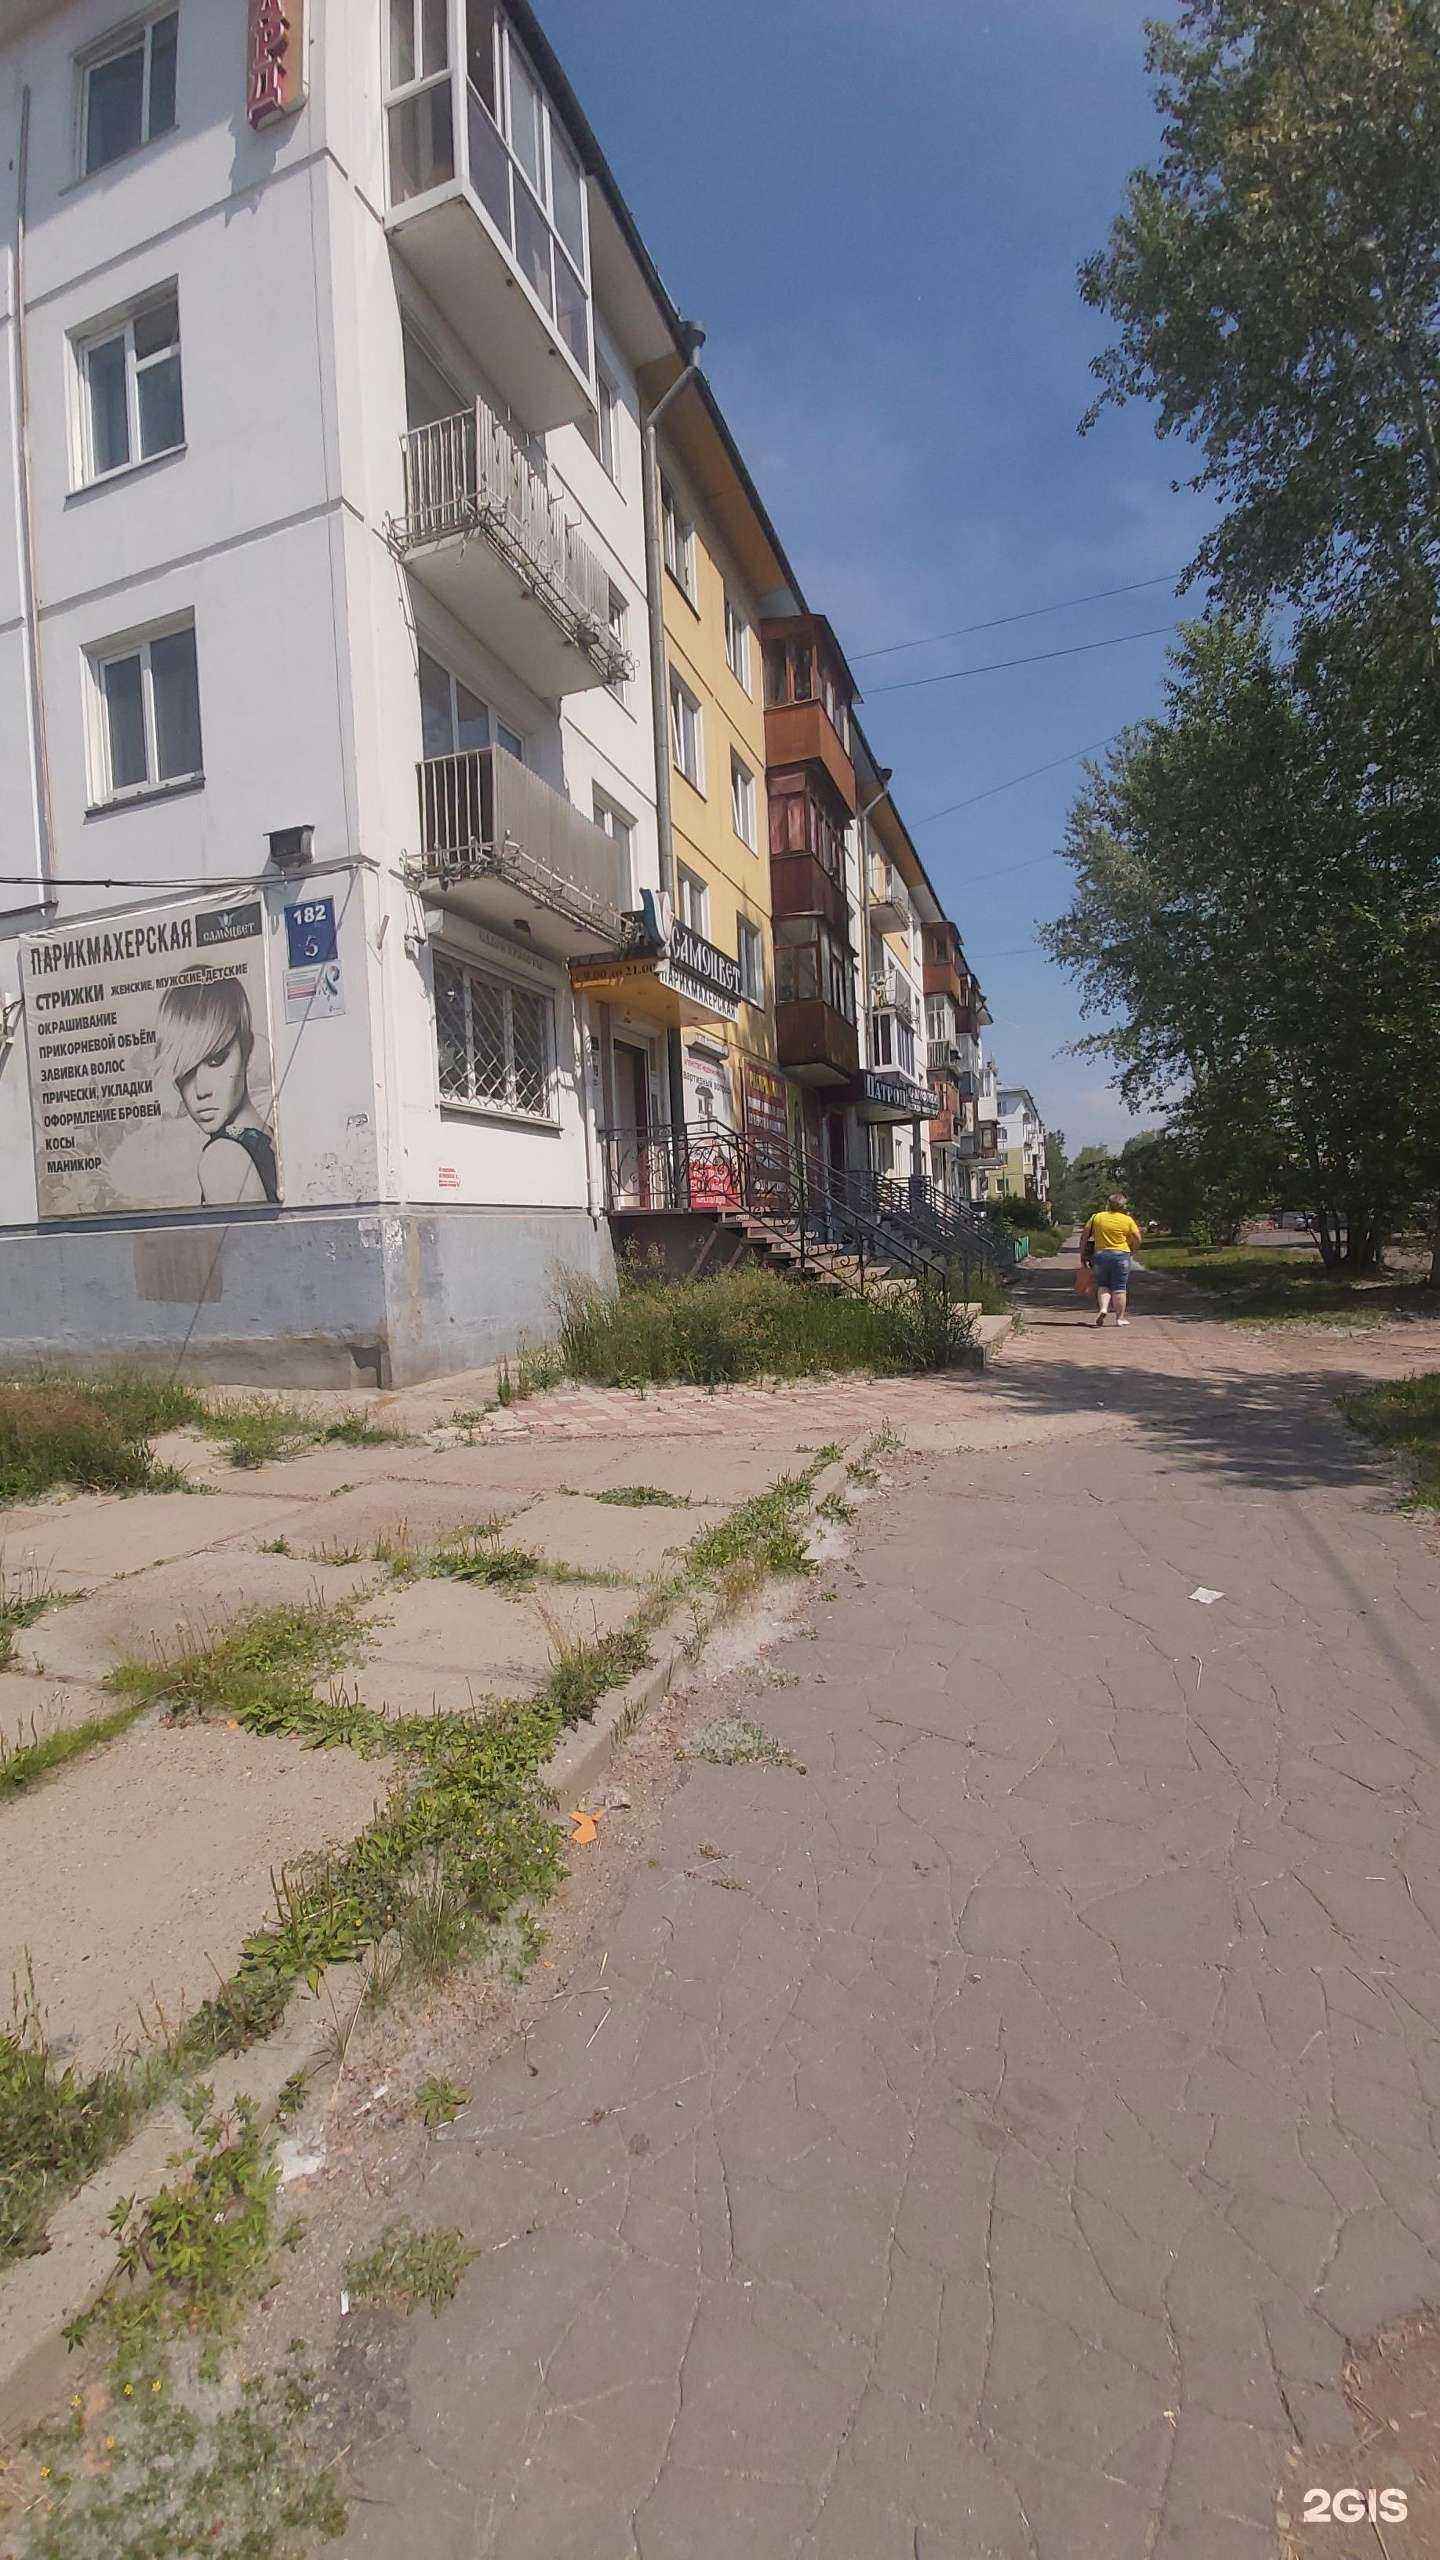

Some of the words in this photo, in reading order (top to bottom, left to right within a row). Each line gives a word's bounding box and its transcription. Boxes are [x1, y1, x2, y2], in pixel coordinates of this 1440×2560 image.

[293, 904, 327, 925] 182
[31, 918, 192, 976] ПАРИКМАХЕРСКАЯ
[304, 935, 319, 957] 5
[36, 984, 105, 1012] СТРИЖКИ
[110, 979, 155, 997] ЖЕНСКИЕ,
[205, 963, 249, 982] ДЕТСКИЕ
[37, 1012, 117, 1035] ОКРАШИВАНИЕ
[39, 1033, 116, 1059] ПРИКОРНЕВОЙ
[117, 1029, 157, 1049] ОБЪЁМ
[41, 1065, 88, 1082] ЗАВИВКА
[90, 1059, 126, 1075] ВОЛОС
[42, 1086, 99, 1105] ПРИЧЕСКИ,
[100, 1080, 153, 1098] УКЛАДКИ
[44, 1108, 116, 1128] ОФОРМЛЕНИЕ
[118, 1100, 162, 1119] БРОВЕЙ
[45, 1136, 75, 1151] КОСЫ
[47, 1157, 102, 1174] МАНИКЮР
